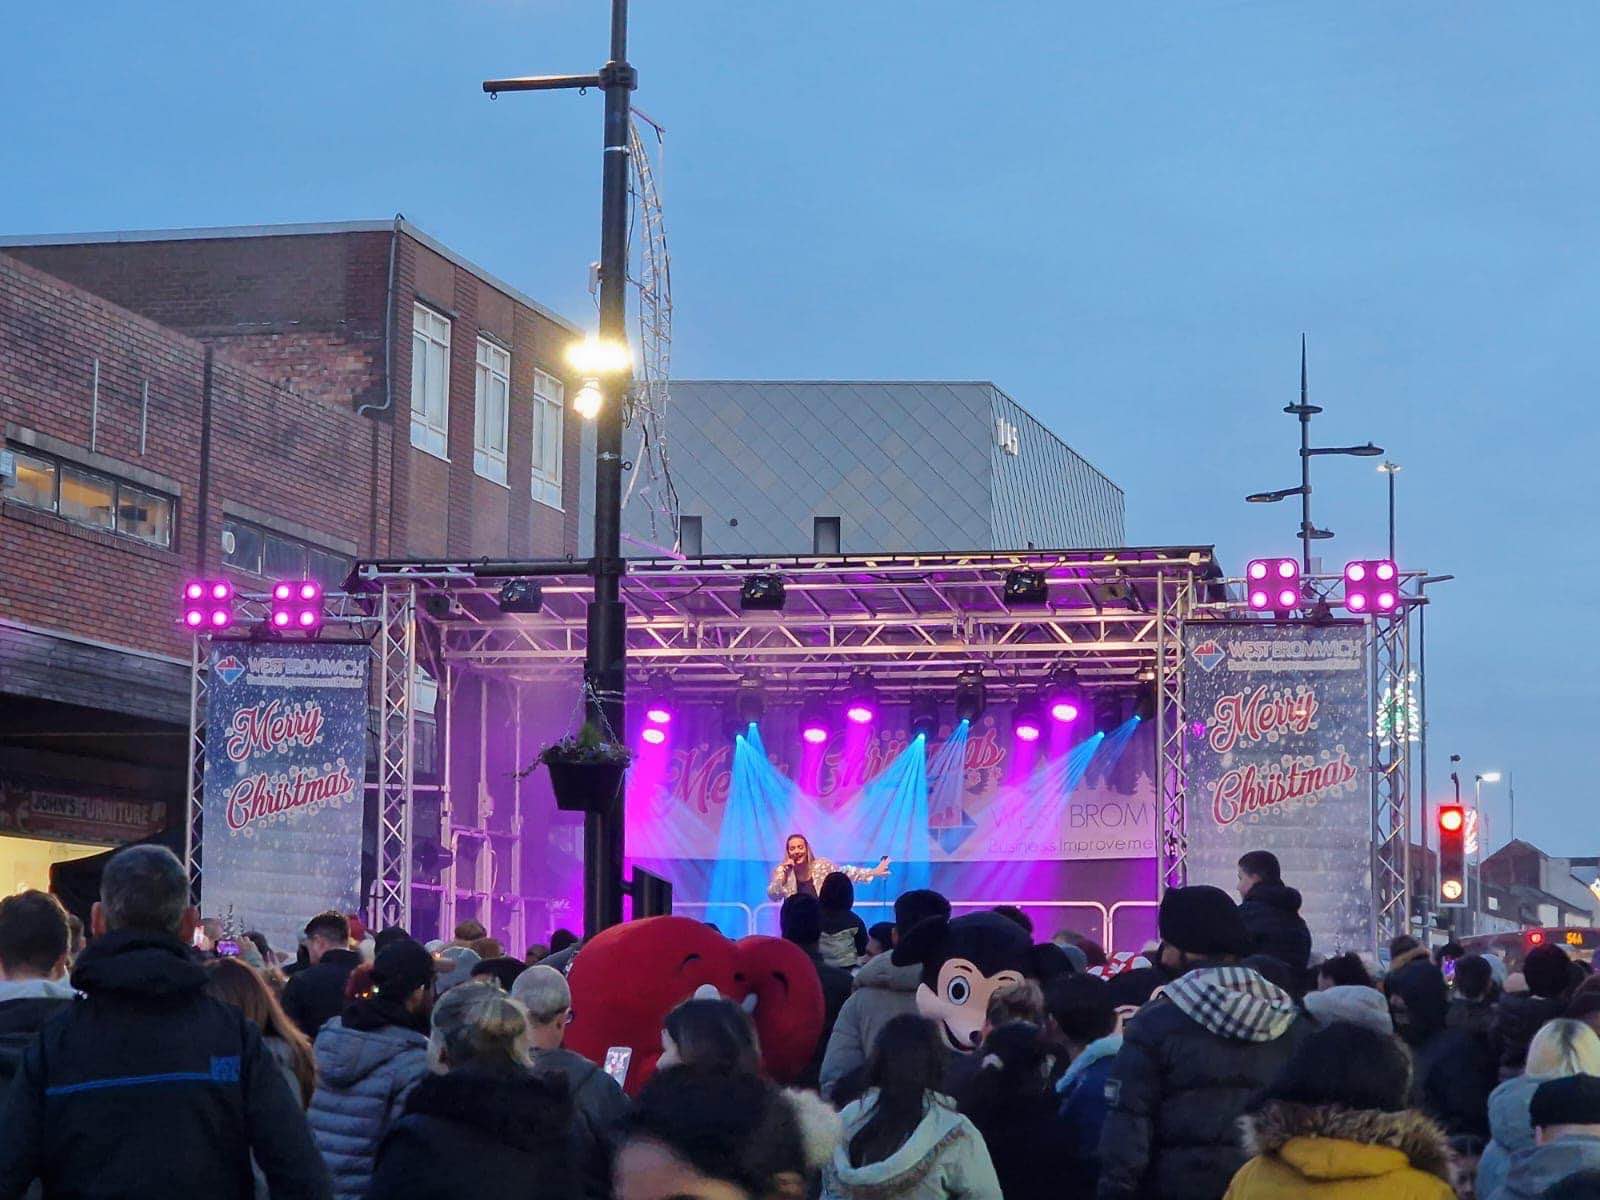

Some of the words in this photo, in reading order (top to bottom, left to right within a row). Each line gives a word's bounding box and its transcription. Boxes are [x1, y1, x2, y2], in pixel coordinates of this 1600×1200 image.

[247, 656, 285, 674] WEST
[285, 658, 365, 677] BROMWICH
[1227, 640, 1271, 658] WEST
[1271, 640, 1362, 658] BROMWICH
[226, 699, 324, 762] Merry
[1209, 684, 1319, 753] Merry
[815, 727, 1006, 798] Chrias
[33, 793, 79, 816] JOHN'S
[80, 796, 150, 825] FURNITURE
[225, 766, 355, 830] Christmas
[1212, 753, 1358, 826] Christmas
[1070, 802, 1157, 828] BROM
[1060, 837, 1155, 854] Improveme
